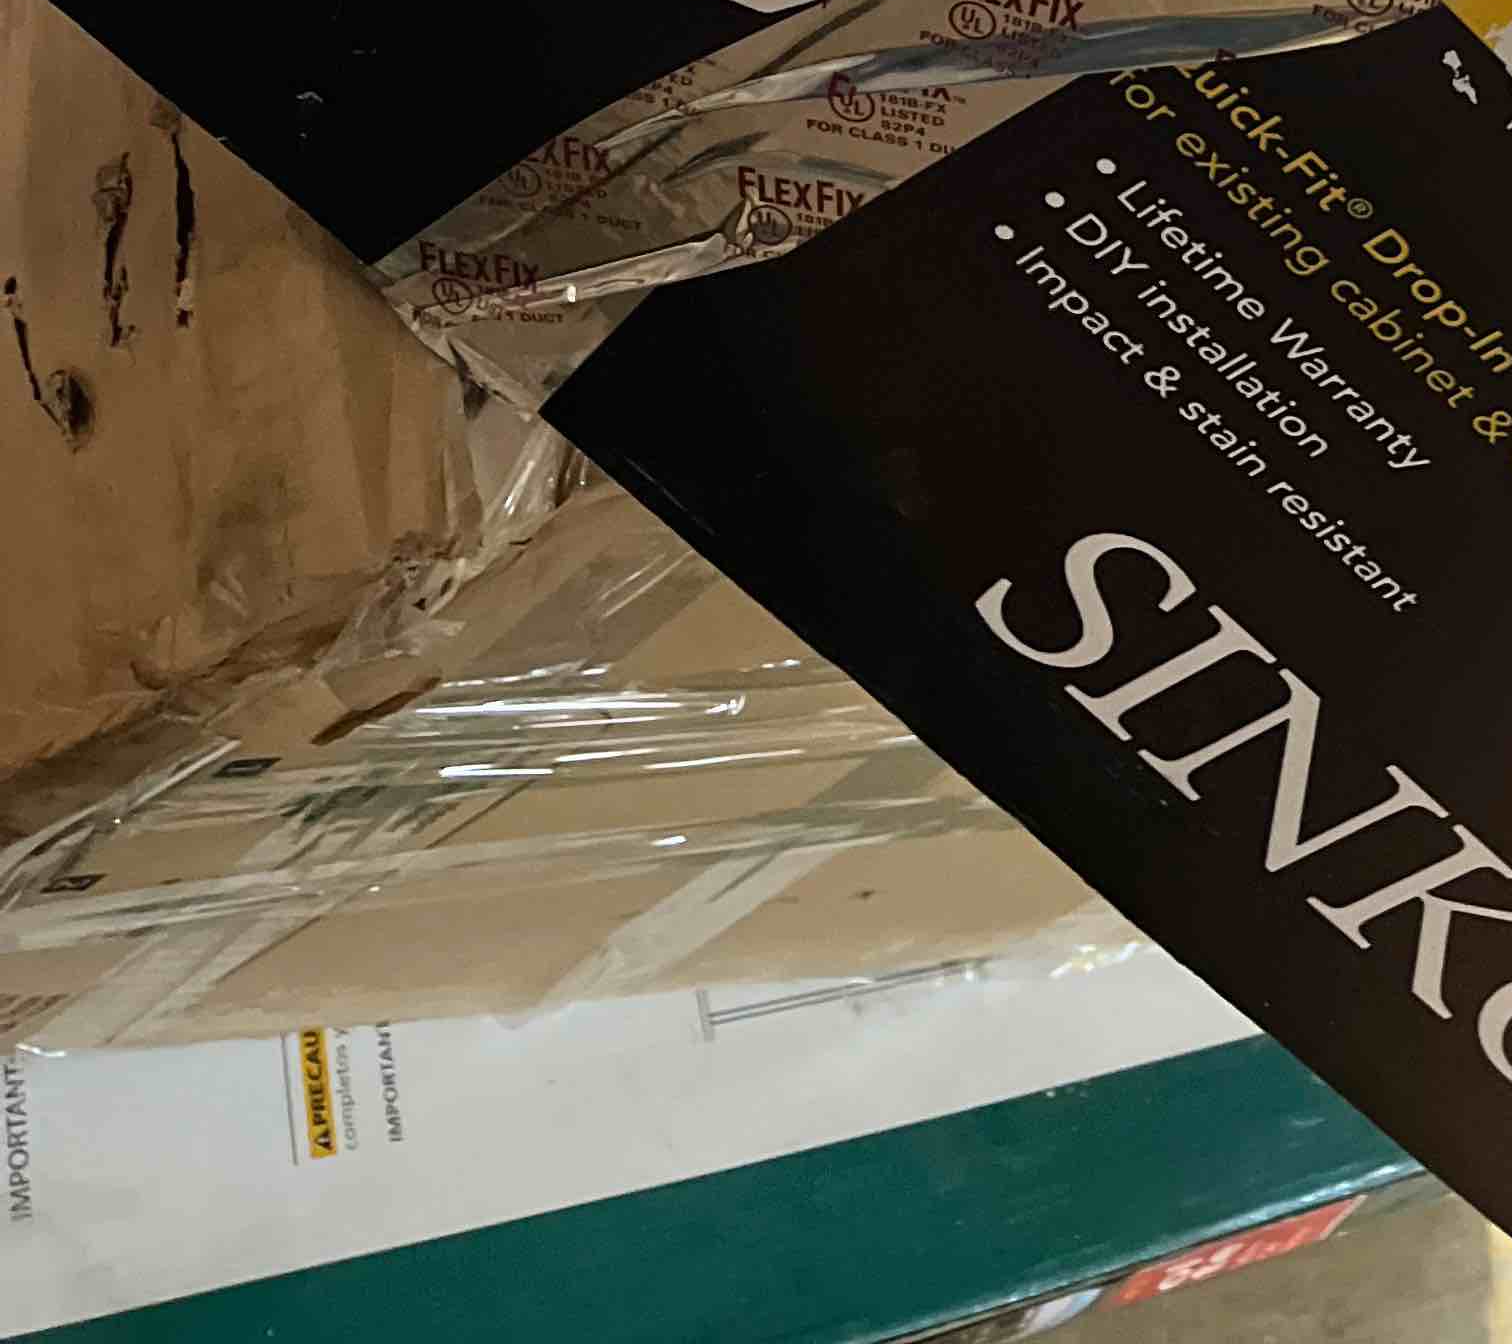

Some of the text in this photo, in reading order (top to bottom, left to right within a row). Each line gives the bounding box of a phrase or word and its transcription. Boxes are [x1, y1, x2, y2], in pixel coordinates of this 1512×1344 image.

[806, 118, 844, 136] FOR
[848, 126, 909, 149] CLASS
[879, 107, 945, 128] LISTED
[880, 119, 927, 138] 82P4
[1108, 66, 1177, 122] for
[1176, 130, 1331, 278] existing
[1330, 277, 1479, 410] cabinet
[1015, 245, 1423, 613] Impact & stain resistant
[1065, 212, 1329, 463] DIY installation
[1115, 180, 1431, 473] Lifetime Warranty
